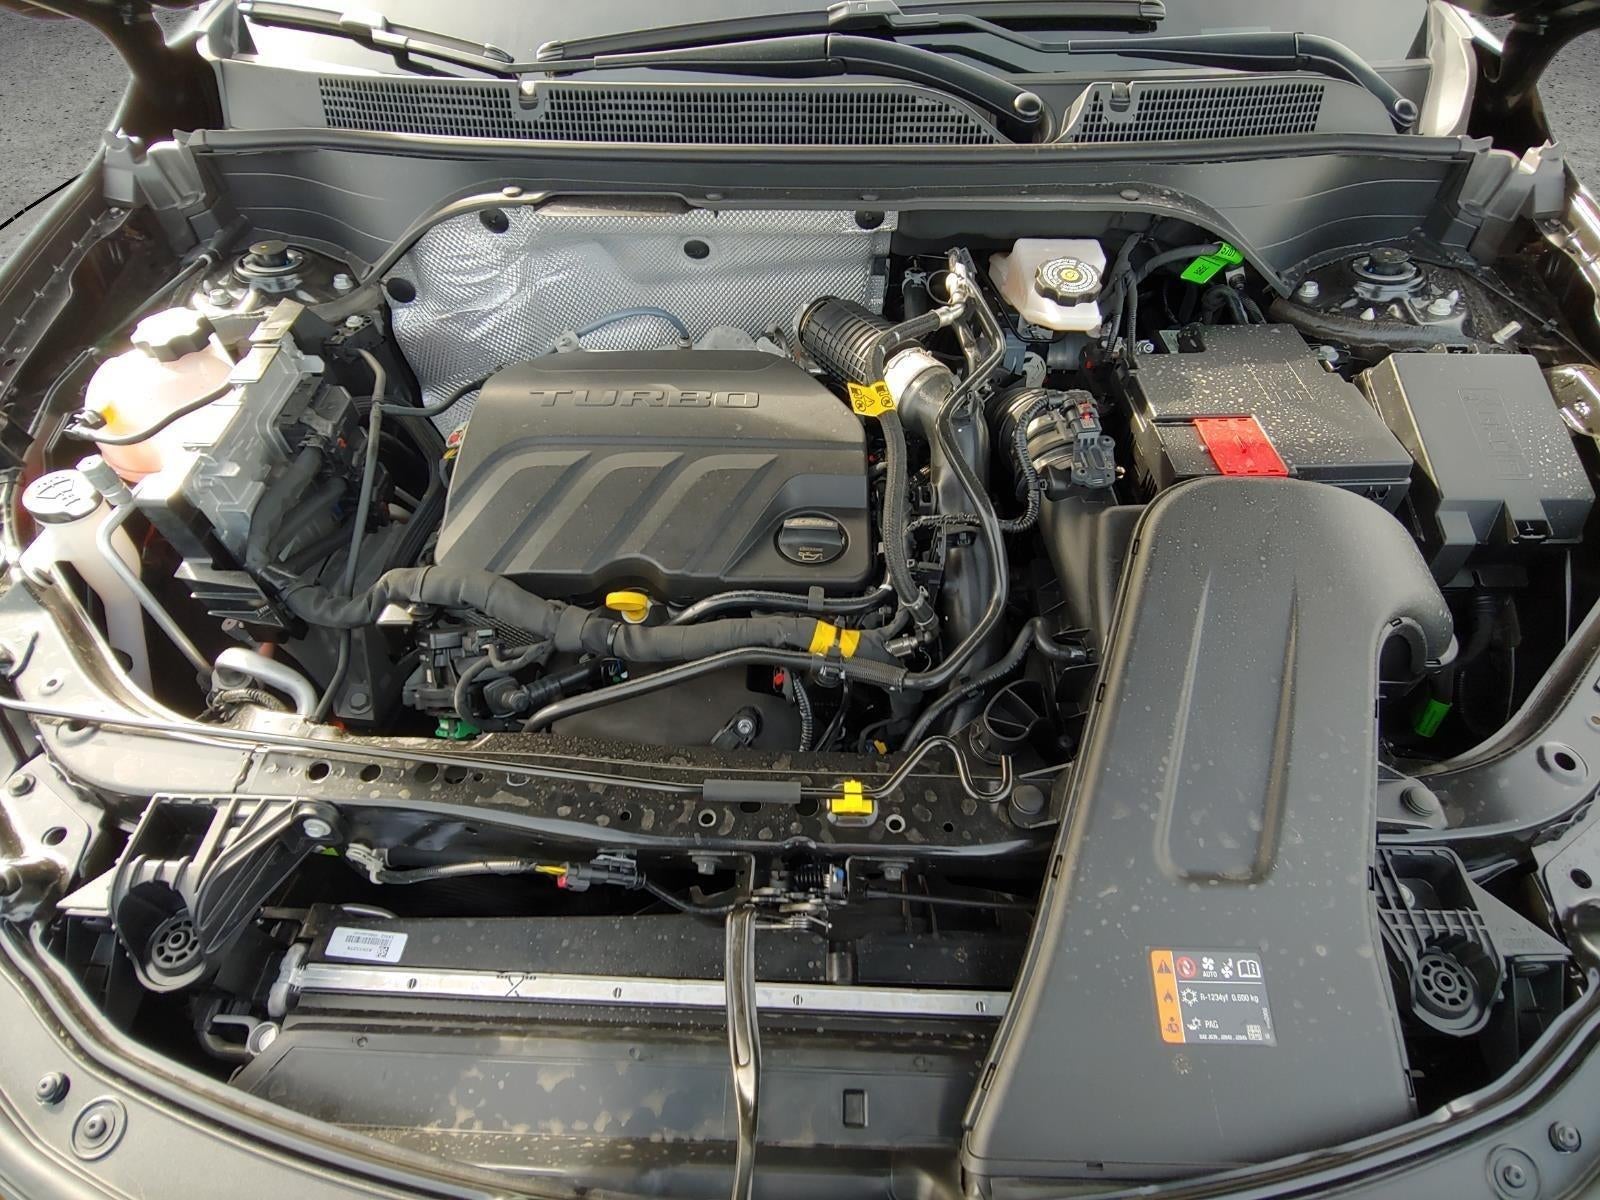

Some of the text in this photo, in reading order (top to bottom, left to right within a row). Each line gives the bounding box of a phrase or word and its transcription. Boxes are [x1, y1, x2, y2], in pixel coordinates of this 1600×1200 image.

[529, 389, 760, 409] TURBO
[1250, 993, 1259, 1003] kg
[1204, 1020, 1219, 1029] PAG
